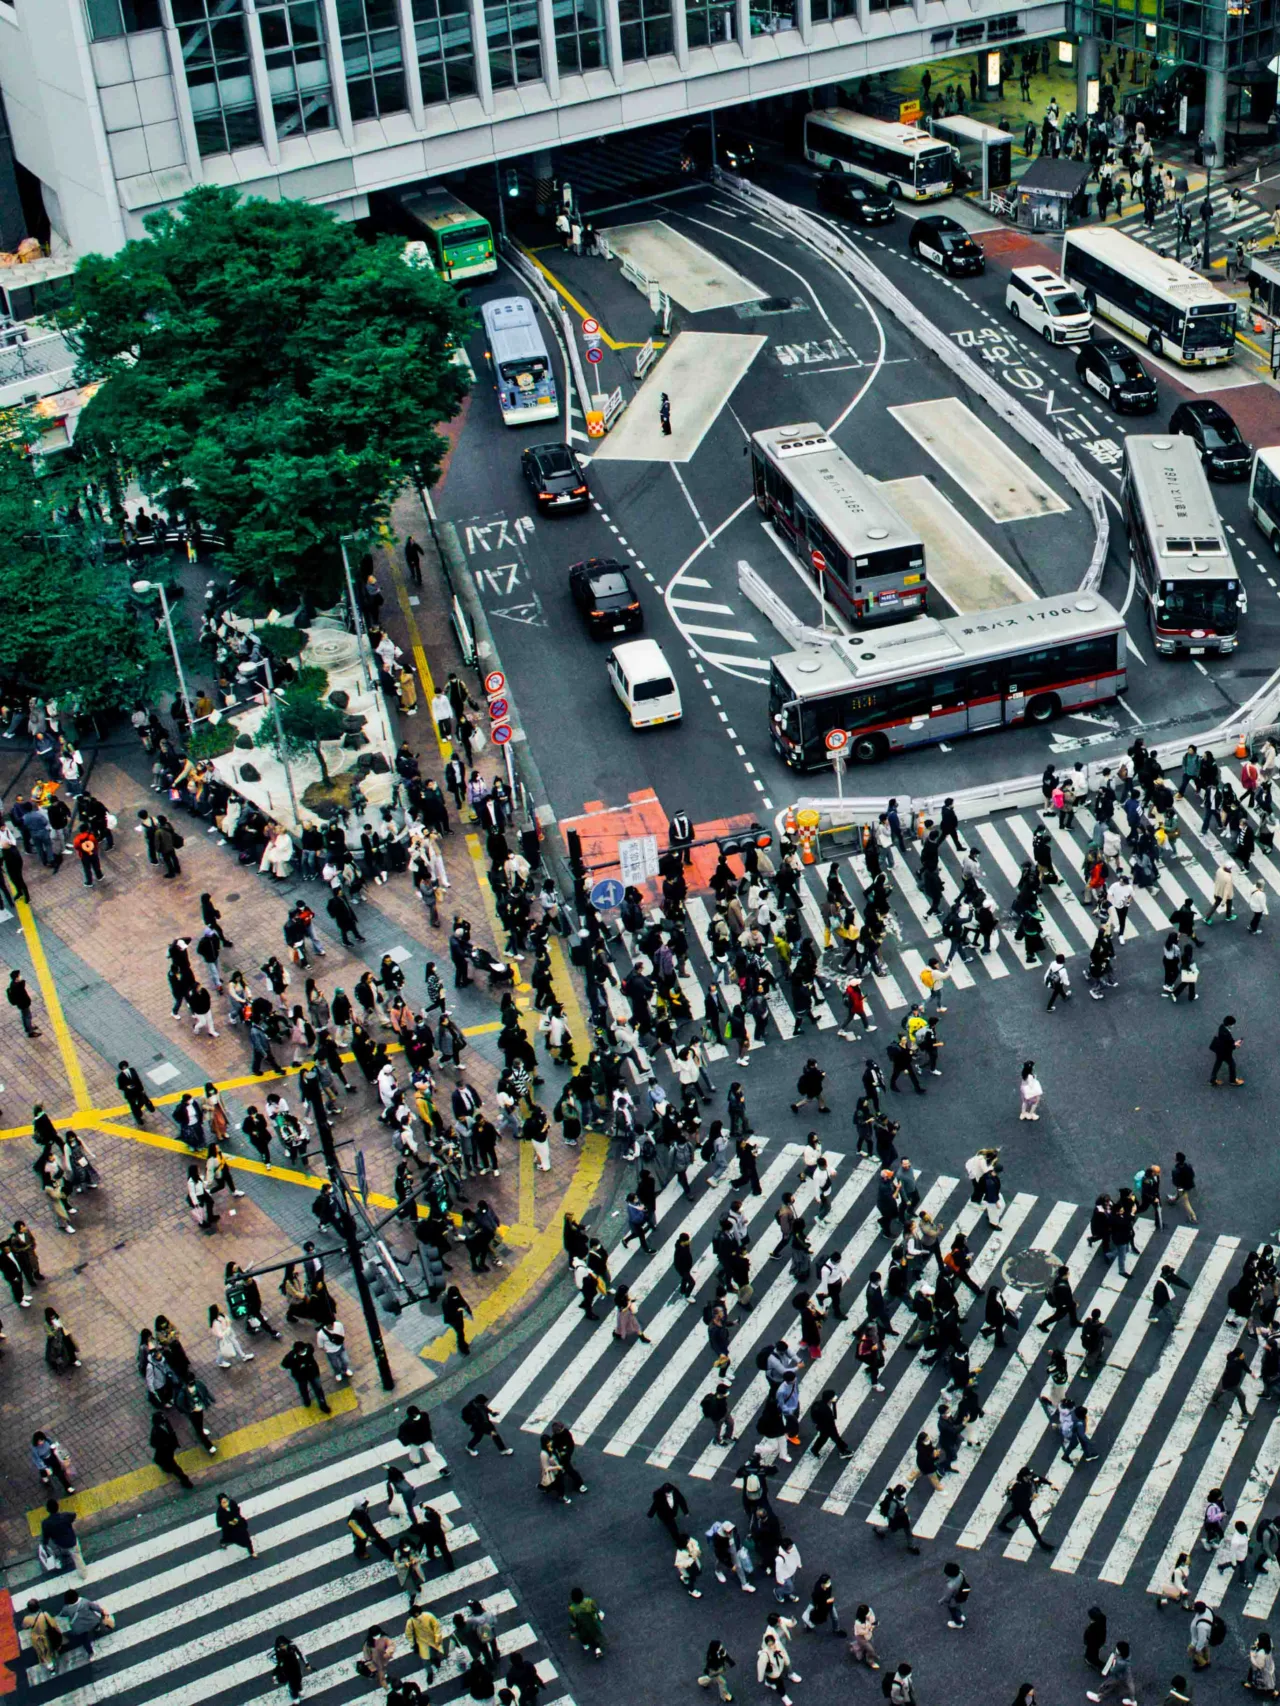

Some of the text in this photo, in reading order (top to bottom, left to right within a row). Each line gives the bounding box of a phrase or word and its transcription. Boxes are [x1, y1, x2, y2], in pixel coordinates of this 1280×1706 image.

[962, 607, 1072, 636] 東急バス 1706
